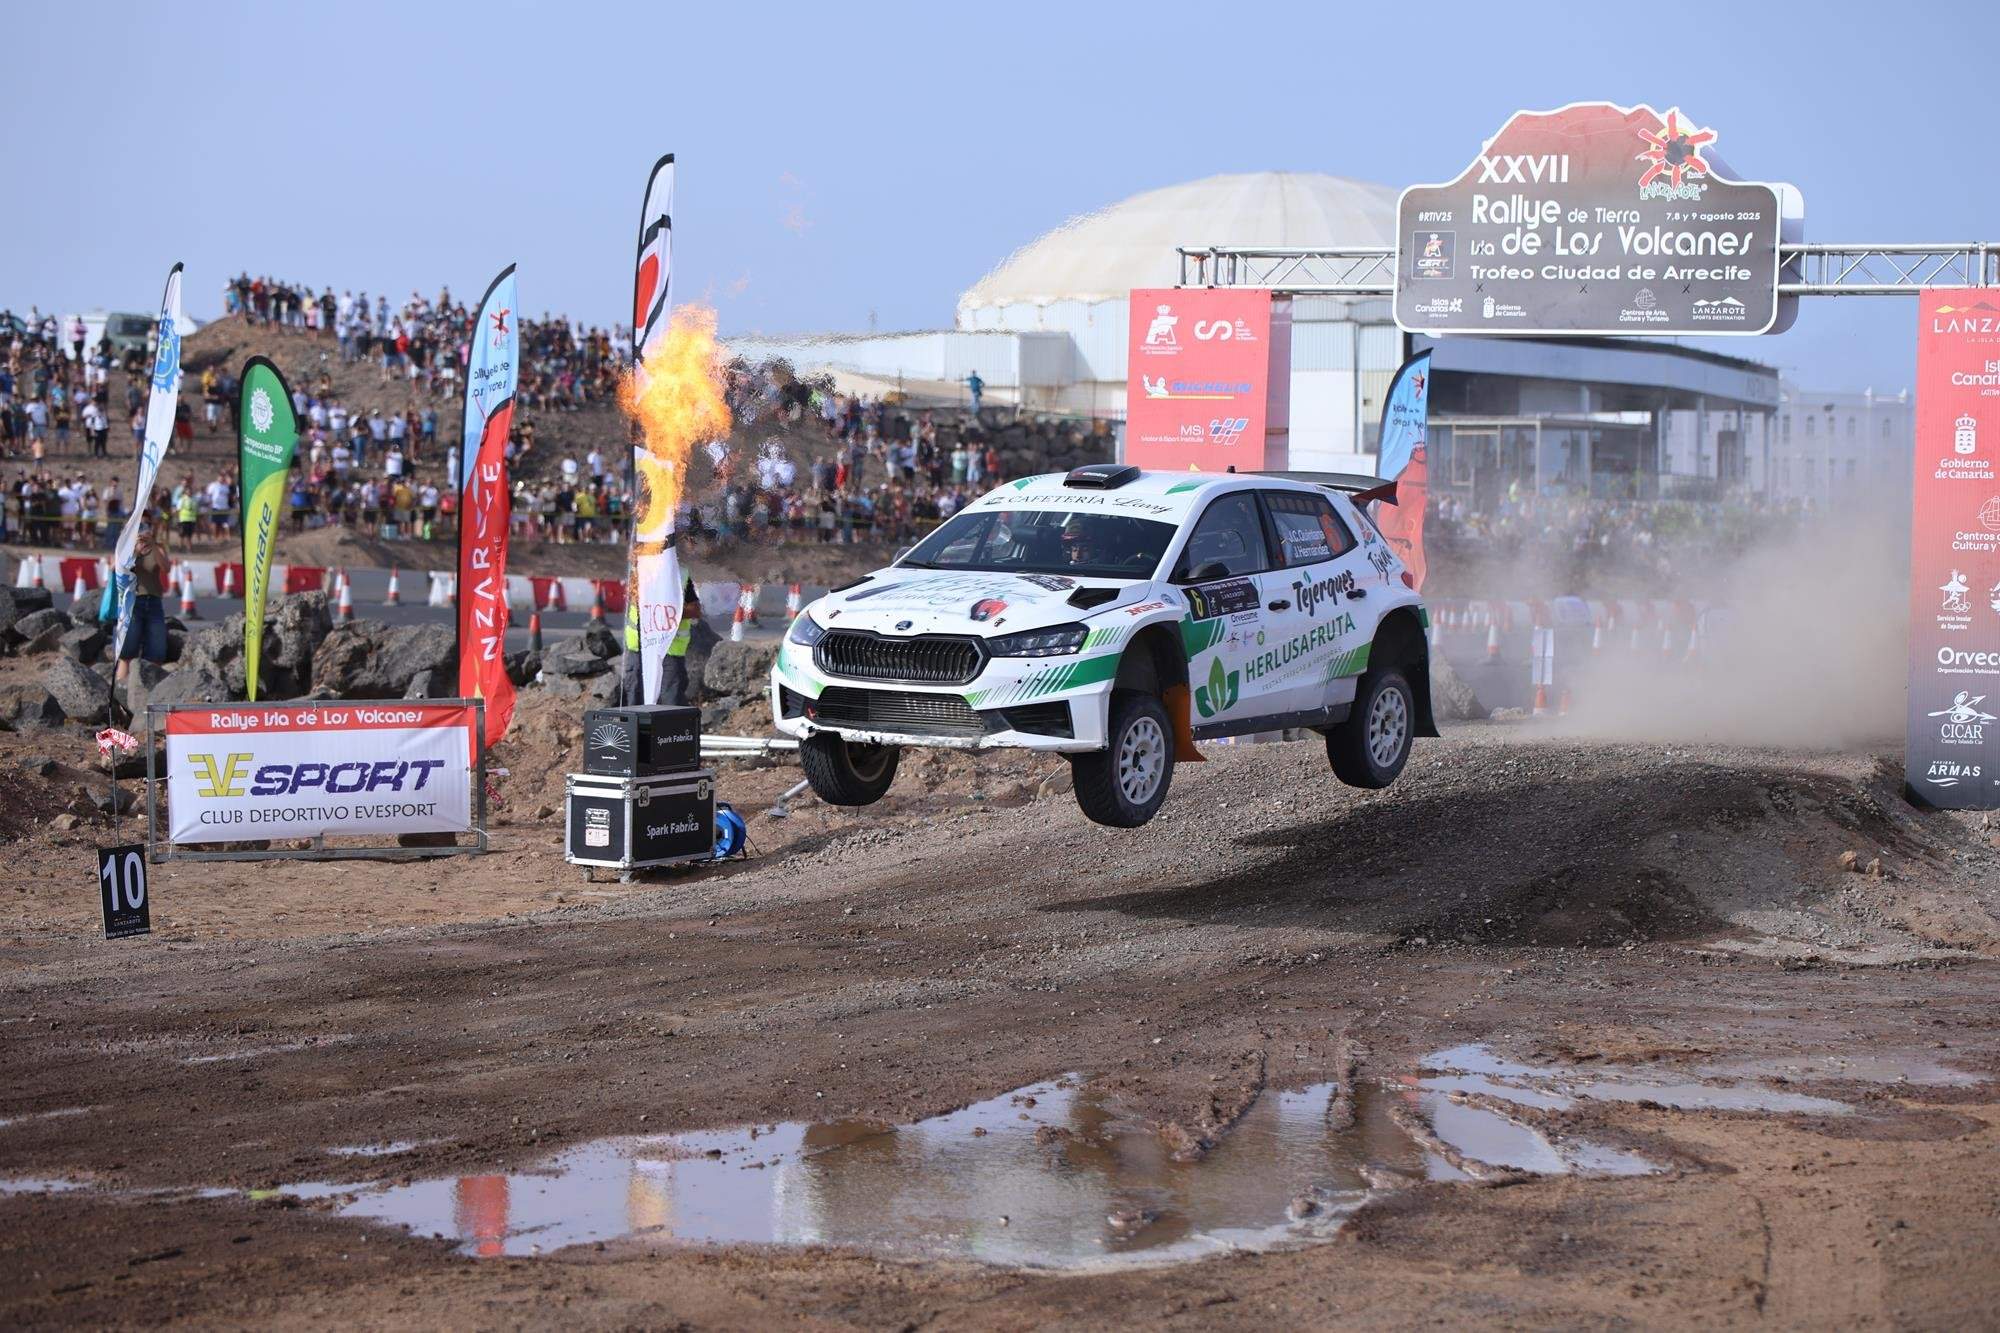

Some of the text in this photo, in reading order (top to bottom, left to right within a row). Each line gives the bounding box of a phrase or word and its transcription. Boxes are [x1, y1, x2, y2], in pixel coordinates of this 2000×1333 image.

[1478, 154, 1569, 184] XXVII
[1472, 194, 1640, 228] Rallye de Tierra
[1682, 213, 1689, 223] y
[1691, 212, 1697, 221] 9
[1699, 212, 1735, 223] agosto
[1737, 212, 1761, 221] 2025
[1501, 226, 1542, 256] de
[1555, 226, 1603, 256] Los
[1618, 226, 1753, 256] Volcanes
[1470, 265, 1752, 281] Trofeo Ciudad de Arrecife
[1431, 298, 1449, 306] Islas
[1415, 304, 1449, 313] Canarias
[1692, 307, 1746, 315] LANZAROTE
[1646, 315, 1669, 323] Turismo
[1940, 458, 1989, 469] Gobierno
[1935, 468, 1995, 479] de Canarias
[1008, 493, 1105, 505] CAFETERÍA
[1955, 531, 1996, 541] Centros
[1952, 541, 1997, 552] Cultura y
[1245, 611, 1356, 684] HERLUSAFRUTA
[211, 708, 423, 731] Rallye Isla de Los Volcanes
[1941, 723, 1983, 739] CICAR
[657, 734, 693, 746] Spark Fabrica
[1927, 764, 1981, 777] ARMAS
[200, 802, 438, 825] CLUB DEPORTIVO EVESPORT
[646, 820, 700, 840] Spark Fabrica
[102, 851, 145, 912] 10
